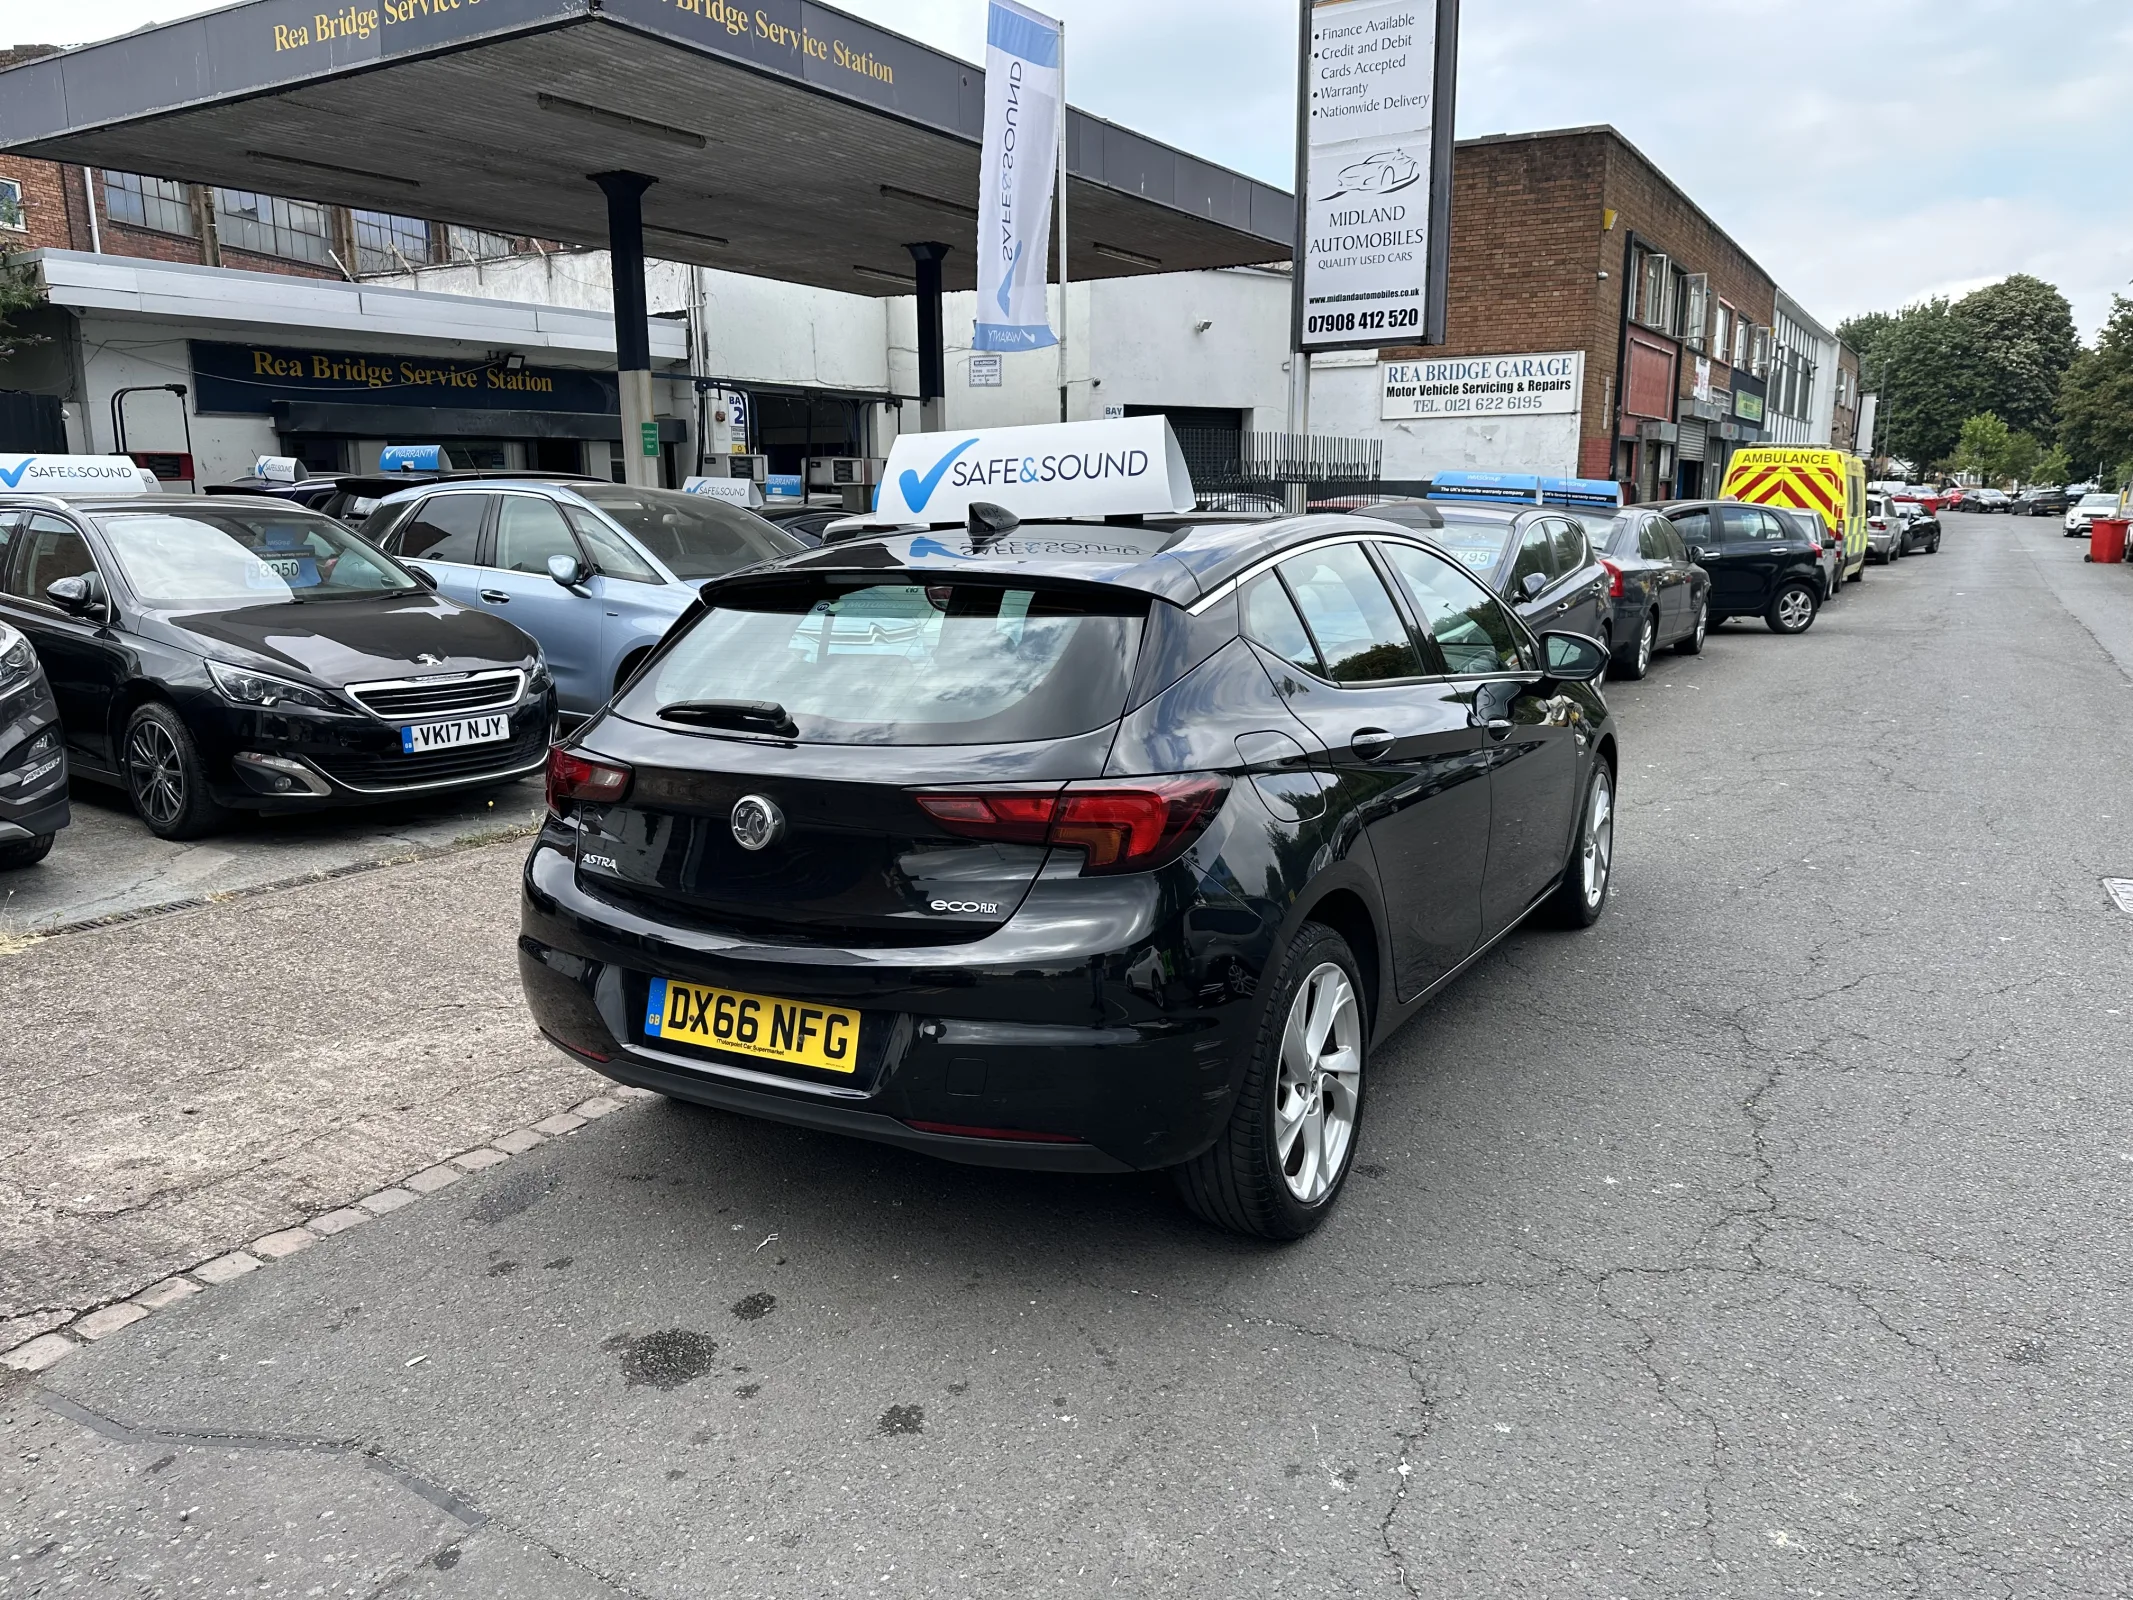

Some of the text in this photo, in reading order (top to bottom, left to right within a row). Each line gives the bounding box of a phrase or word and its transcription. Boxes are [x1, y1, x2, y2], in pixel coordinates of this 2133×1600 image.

[273, 25, 309, 51] Rea
[314, 6, 378, 40] Bridge
[1322, 13, 1415, 40] Finance Available
[755, 10, 828, 60] Service
[833, 39, 894, 85] Station
[1321, 34, 1412, 60] Credit and Debit
[1321, 54, 1406, 79] Cards Accepted
[1320, 83, 1369, 99] Warranty
[1320, 93, 1430, 119] Nationwide Delivery
[1329, 205, 1406, 227] MIDLAND
[1310, 228, 1424, 254] AUTOMOBILES
[1318, 251, 1412, 270] QUALITY USED CARS
[1309, 288, 1419, 304] www.midlandautomobiles.co.uk
[1308, 308, 1419, 333] 07908 412 520
[252, 351, 553, 393] Rea Bridge Service Station
[1388, 357, 1572, 383] REA BRIDGE GARAGE
[1386, 378, 1571, 398] Motor Vehicle Servicing & Repairs
[729, 396, 746, 405] BA
[1413, 395, 1543, 412] TEL. 0121 622 6195
[734, 406, 744, 424] 2
[1105, 407, 1122, 415] BAY
[395, 448, 435, 458] WARRANTY
[1742, 453, 1831, 465] AMBULANCE
[28, 466, 132, 478] SAFE&SOUND
[265, 463, 293, 474] SAFE&SOUND
[952, 450, 1148, 487] SAFE&SOUND
[699, 486, 746, 497] SAFE&SOUND
[420, 717, 501, 746] VK17 NJY
[582, 854, 617, 868] ASTRA
[648, 1014, 660, 1026] GB
[668, 986, 850, 1060] DX66 NFG
[752, 1044, 785, 1056] Supermarket
